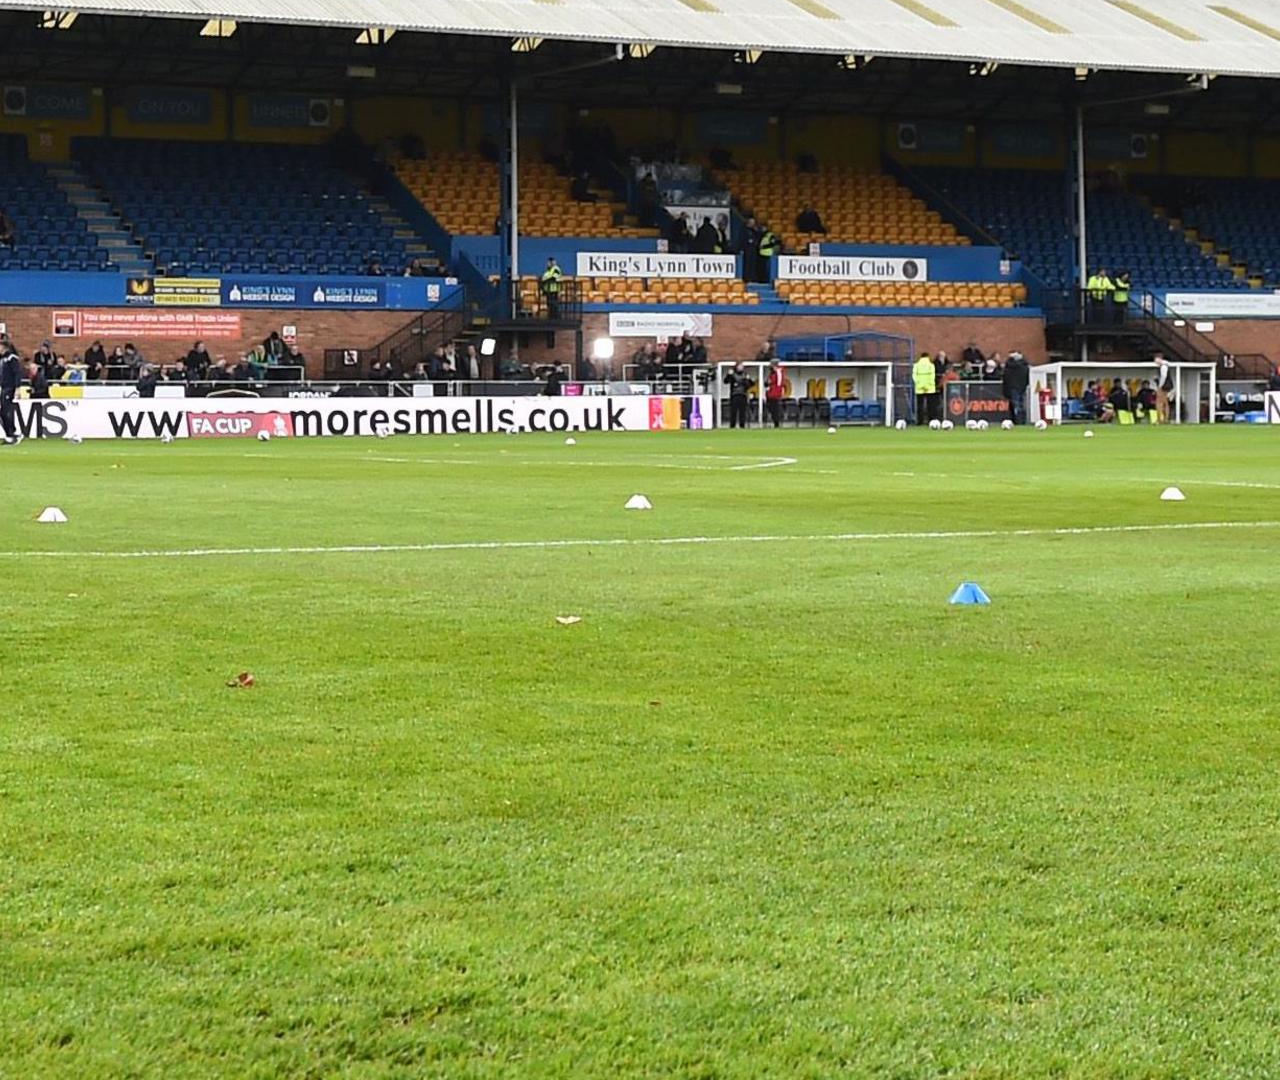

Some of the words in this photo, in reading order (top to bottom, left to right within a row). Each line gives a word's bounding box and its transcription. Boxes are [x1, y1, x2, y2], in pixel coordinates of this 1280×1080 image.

[588, 255, 641, 276] King's
[646, 257, 688, 277] Lynn
[691, 256, 735, 274] Town
[788, 258, 850, 276] Football
[858, 259, 895, 277] Club
[192, 418, 217, 434] FA
[218, 418, 252, 435] CUP
